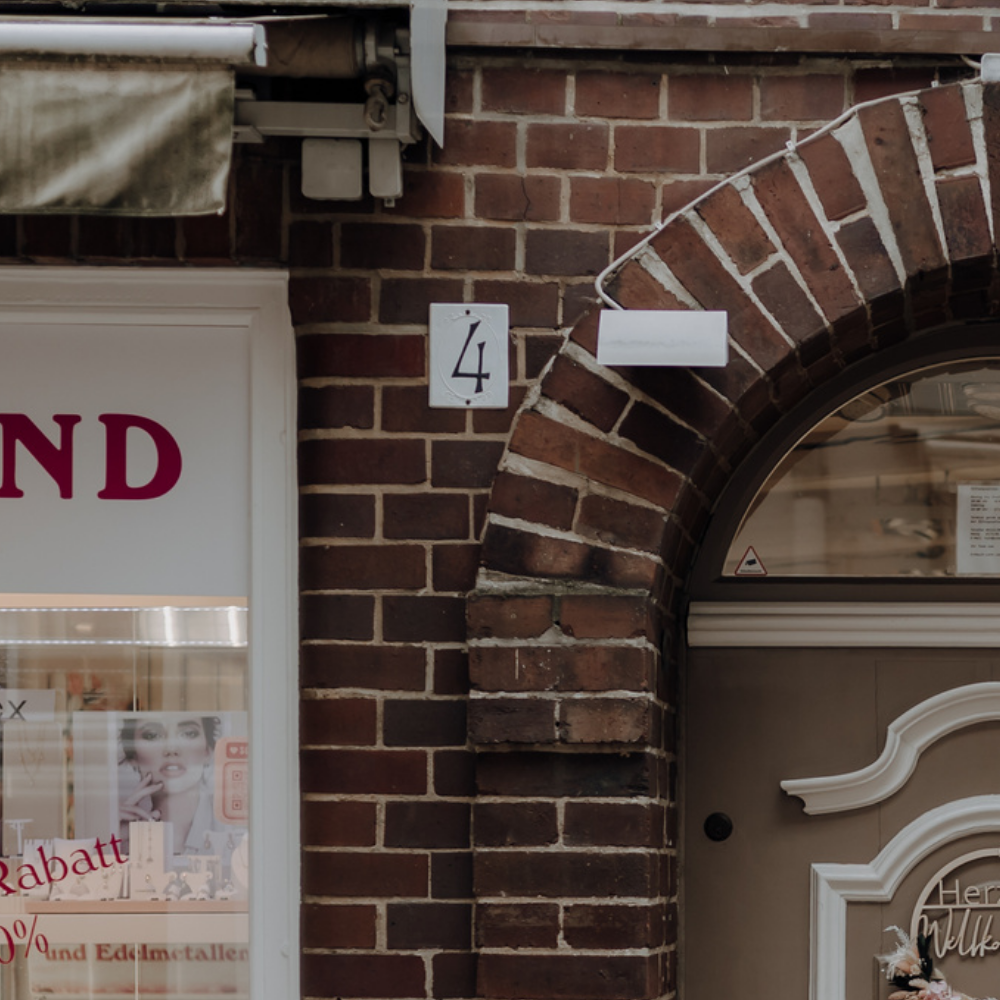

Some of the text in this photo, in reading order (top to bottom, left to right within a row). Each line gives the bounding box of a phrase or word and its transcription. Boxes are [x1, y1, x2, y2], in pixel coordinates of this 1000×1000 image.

[451, 320, 490, 393] 4
[0, 413, 183, 500] ND
[0, 833, 128, 896] Rabatt
[45, 943, 86, 961] und
